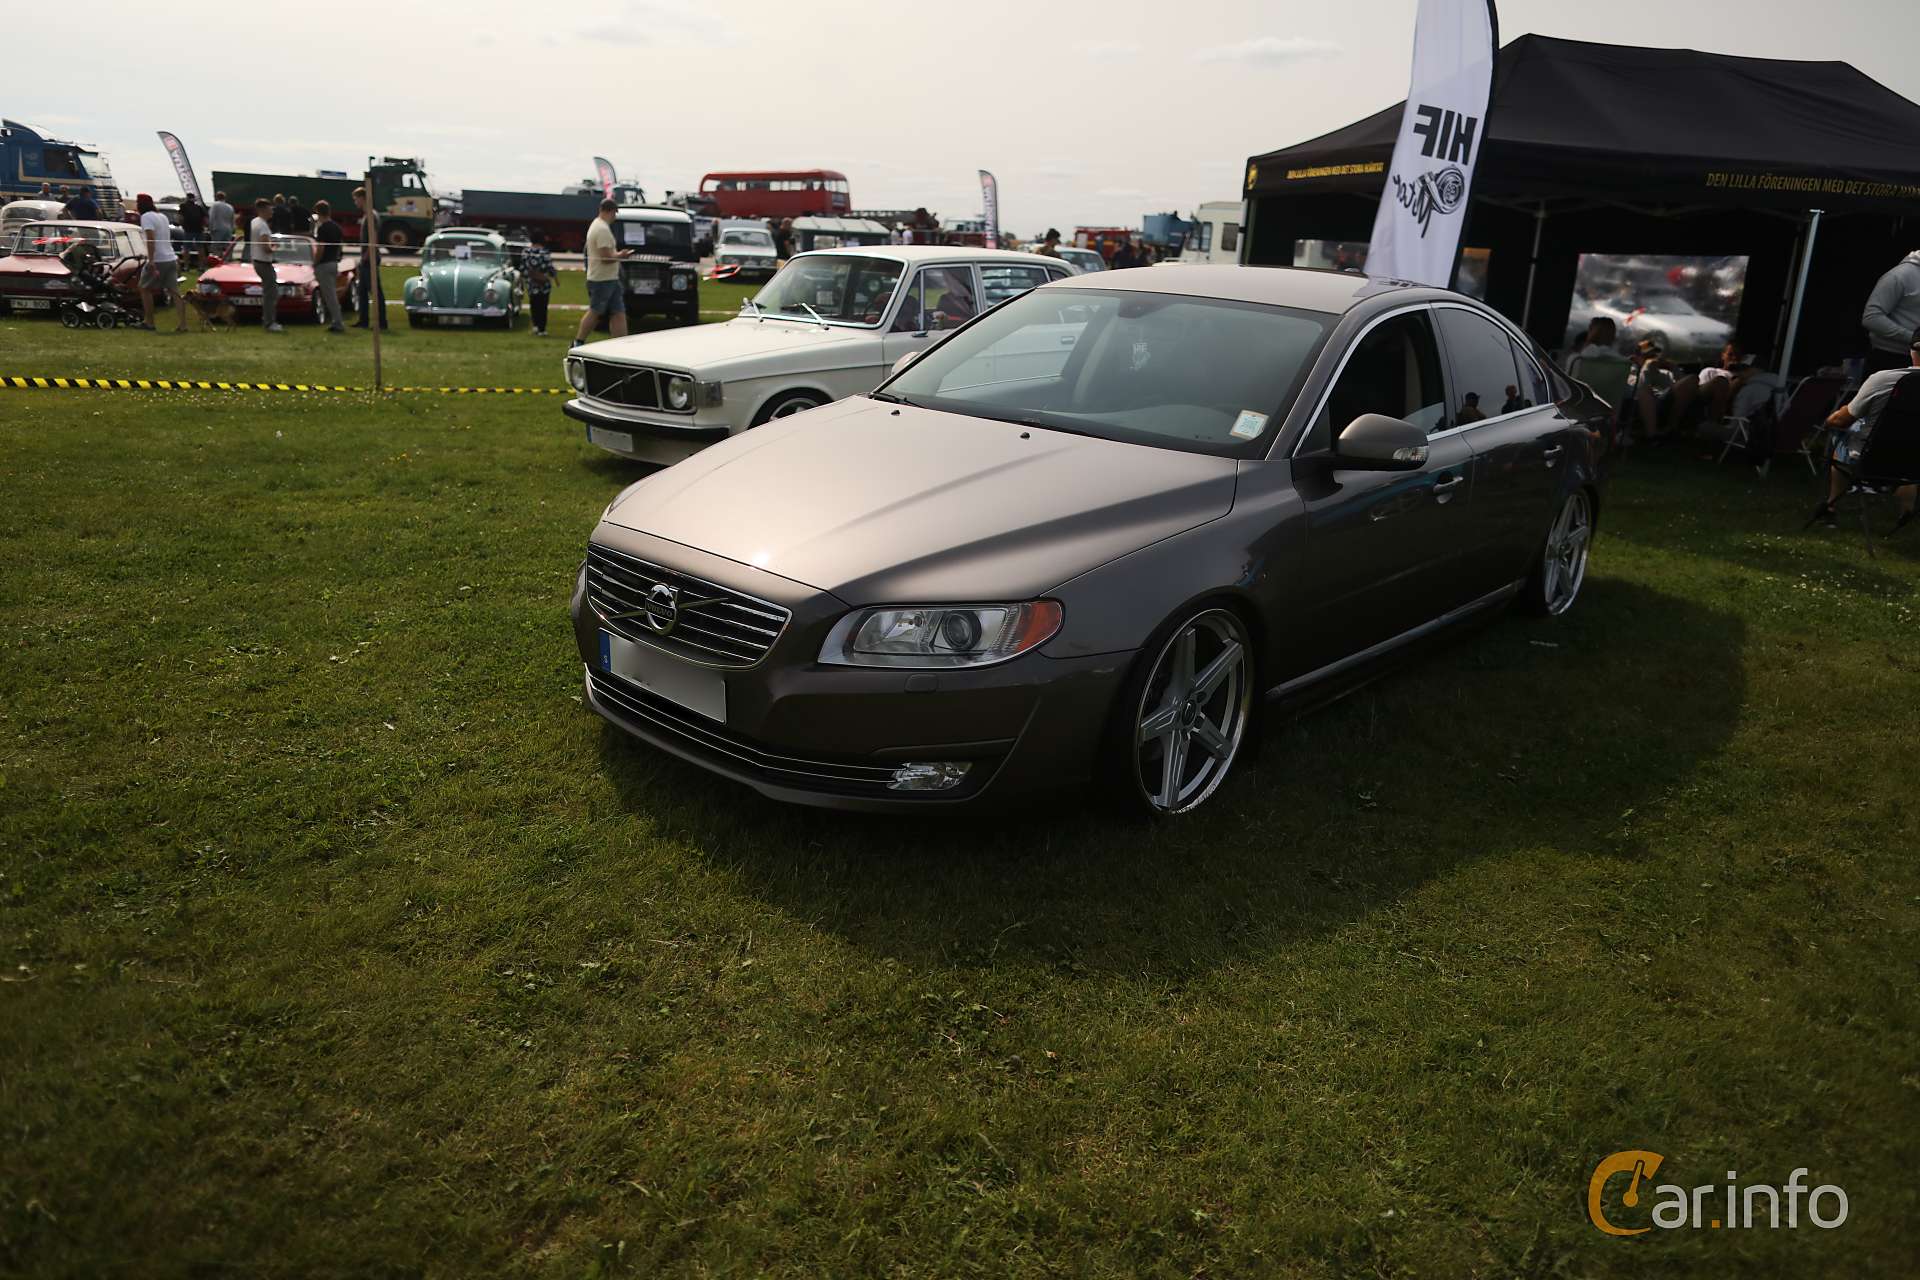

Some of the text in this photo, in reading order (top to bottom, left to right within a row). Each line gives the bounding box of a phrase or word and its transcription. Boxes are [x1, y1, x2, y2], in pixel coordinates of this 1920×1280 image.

[1706, 173, 1728, 188] DEN
[1728, 174, 1757, 189] LILLA
[1758, 172, 1821, 192] FÖRENINGEN
[1822, 178, 1844, 193] MED
[1845, 180, 1866, 194] DET
[647, 603, 673, 618] VOLVO
